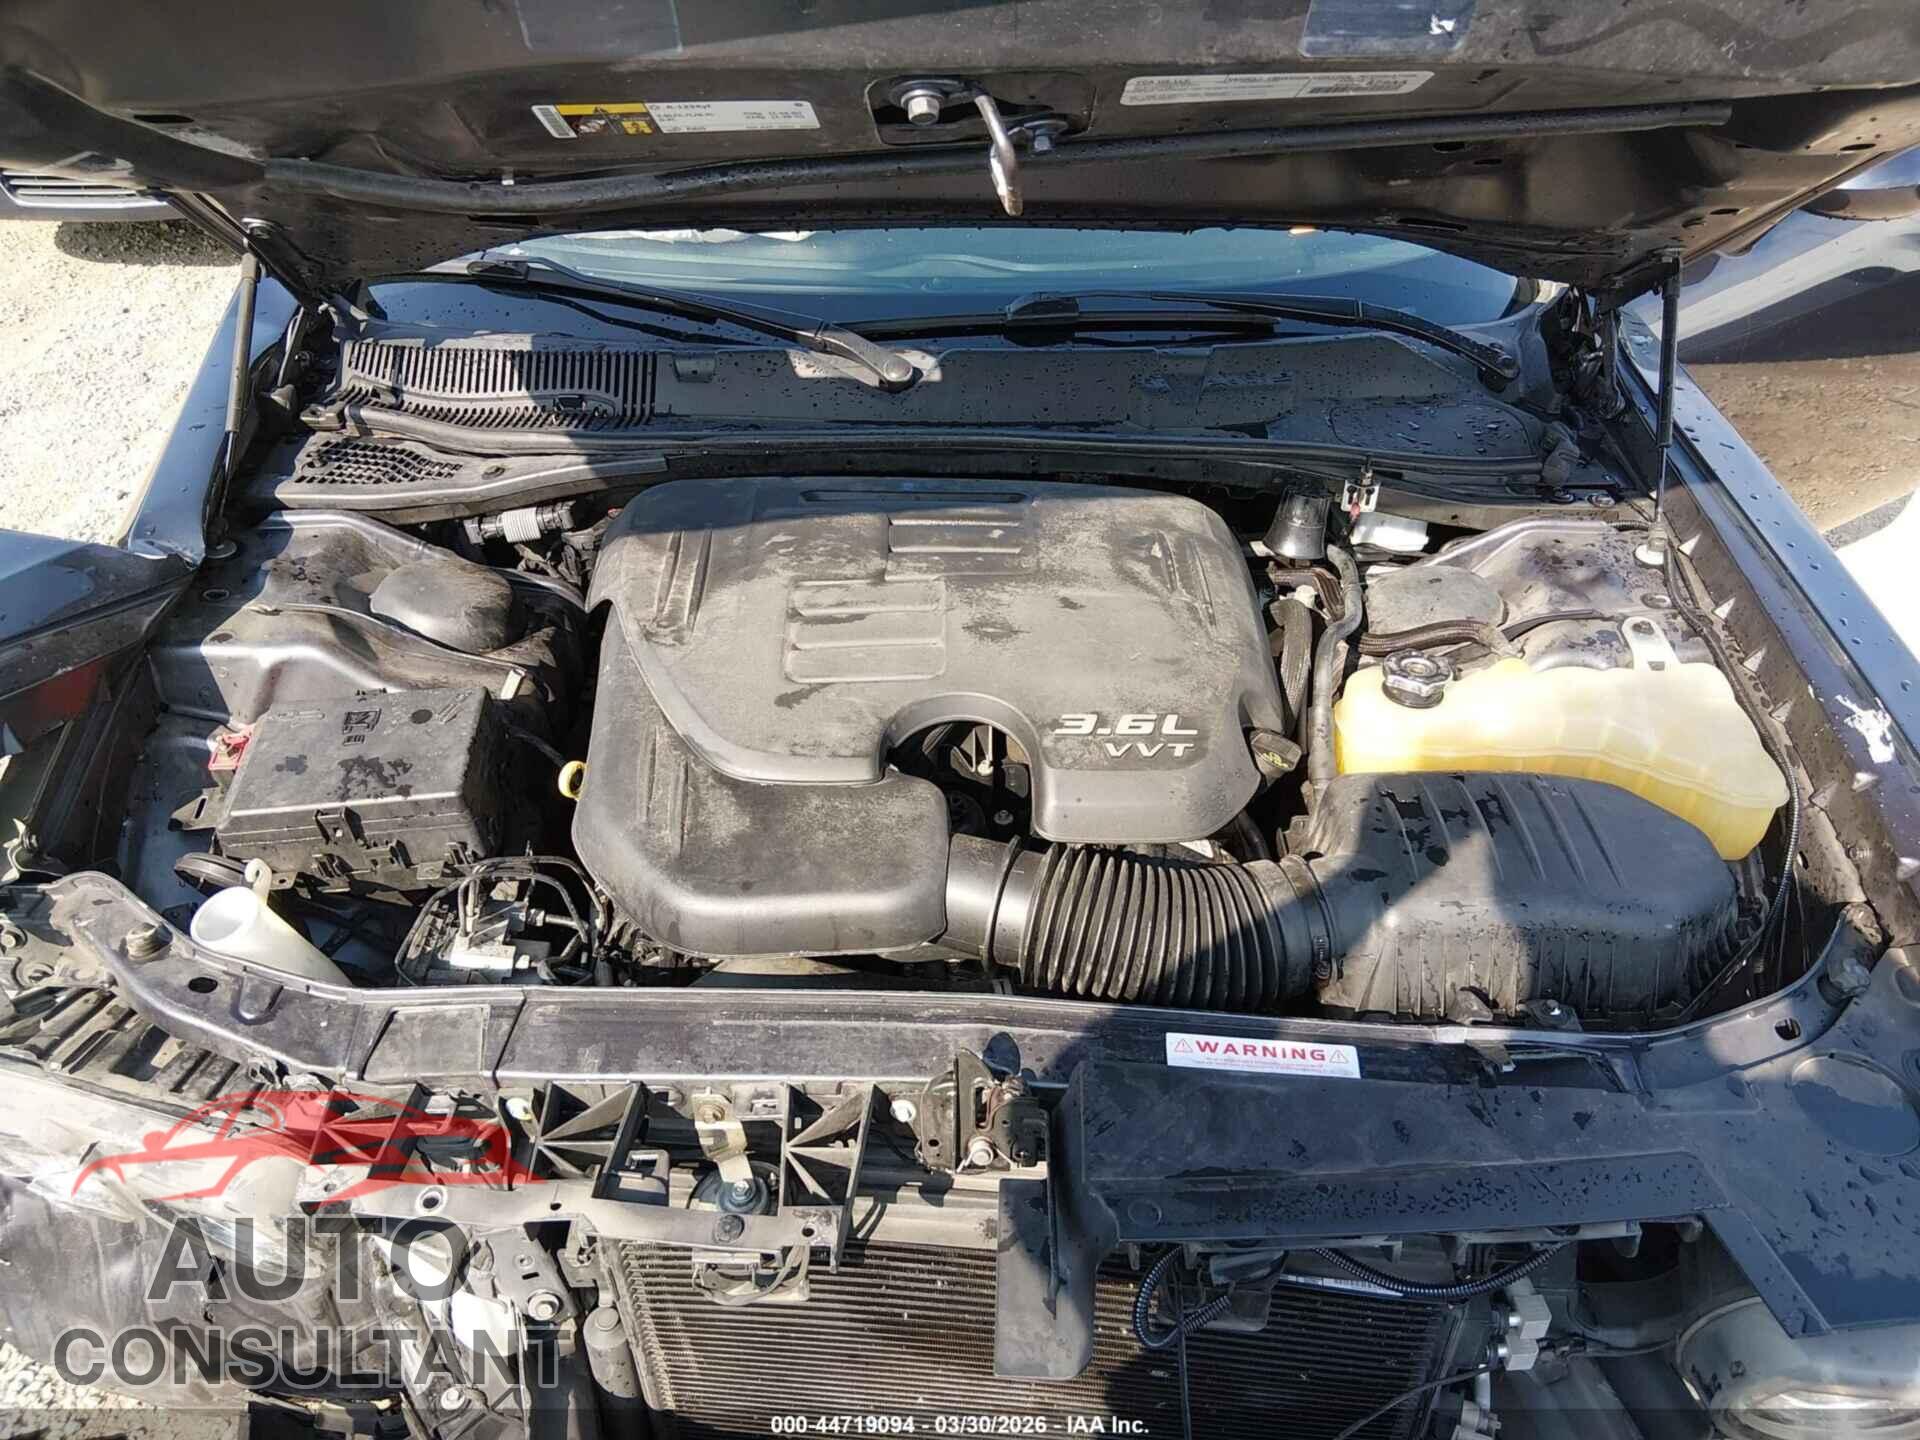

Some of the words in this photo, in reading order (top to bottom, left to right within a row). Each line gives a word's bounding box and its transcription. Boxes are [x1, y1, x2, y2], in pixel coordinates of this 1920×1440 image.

[1053, 713, 1198, 735] 3.6L
[1103, 742, 1195, 757] VVT
[1195, 1040, 1326, 1061] WARNING
